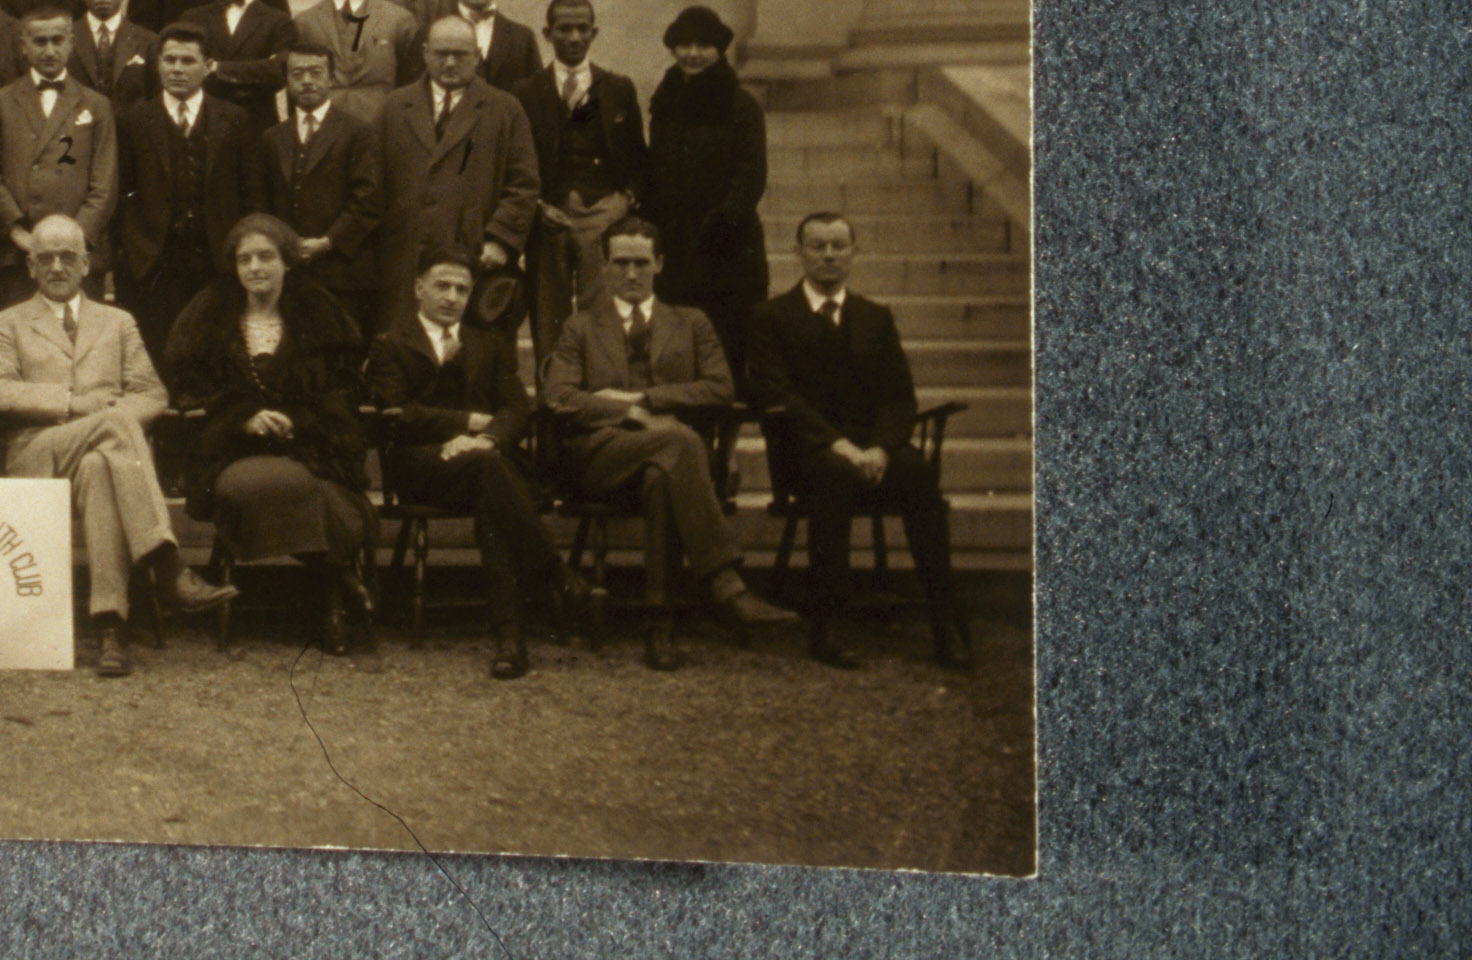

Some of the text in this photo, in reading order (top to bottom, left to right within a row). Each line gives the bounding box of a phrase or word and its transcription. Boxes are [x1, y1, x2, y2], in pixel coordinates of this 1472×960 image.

[343, 14, 370, 52] 7
[57, 135, 77, 166] 2
[9, 552, 43, 597] CLUB
